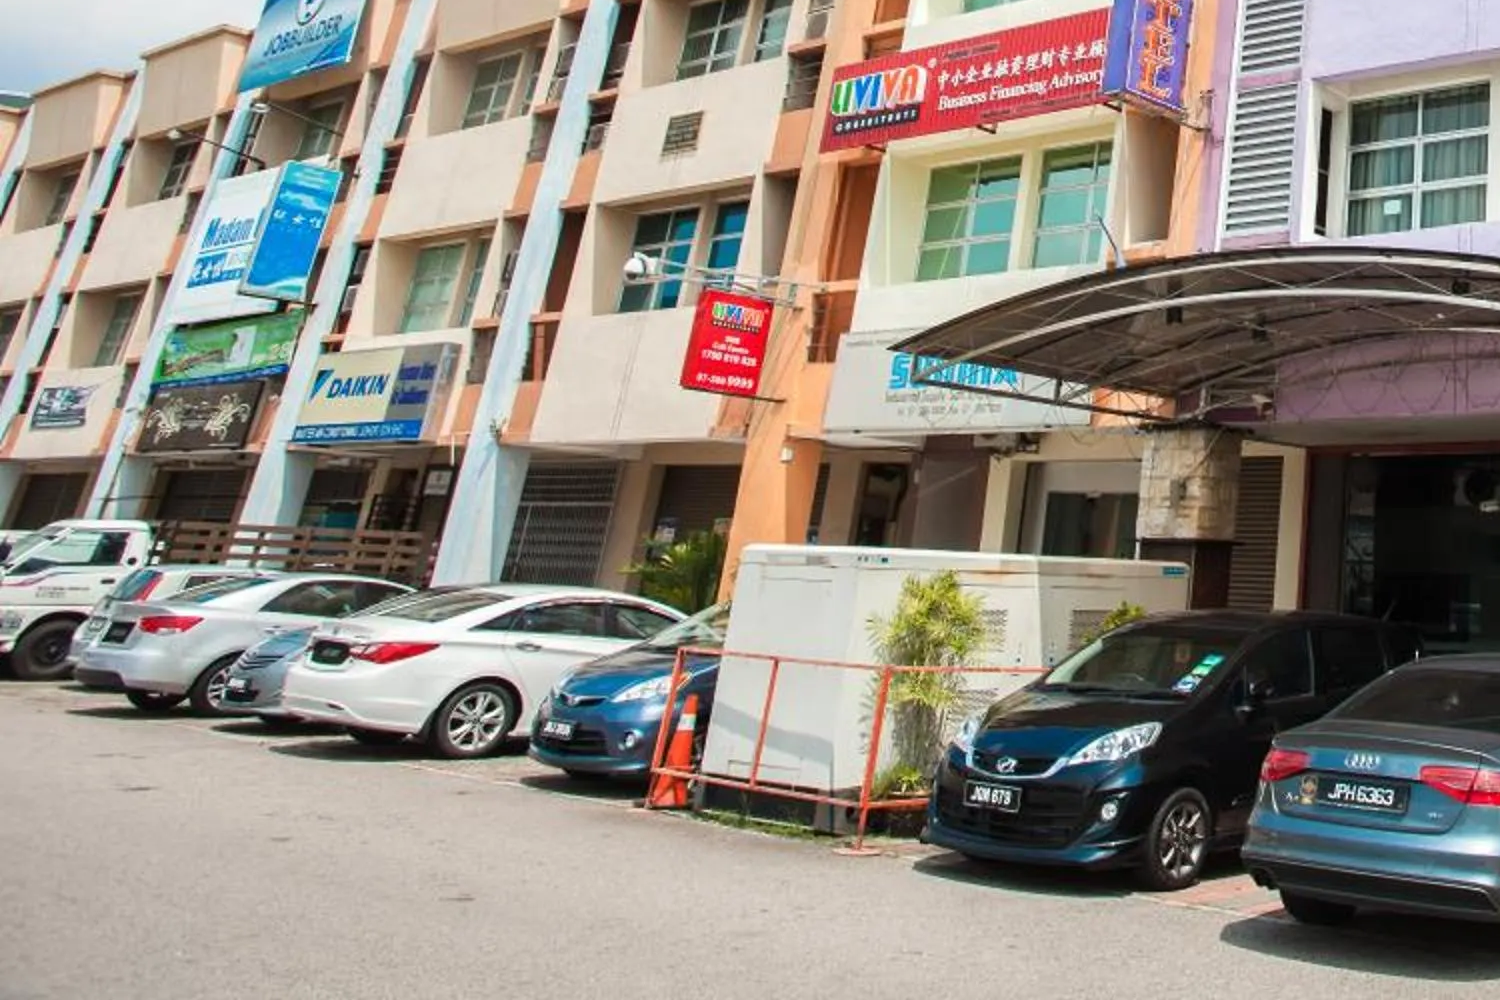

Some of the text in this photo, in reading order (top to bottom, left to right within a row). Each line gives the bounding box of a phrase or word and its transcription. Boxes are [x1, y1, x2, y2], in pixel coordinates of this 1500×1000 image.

[263, 14, 343, 57] JOBBUILDER
[831, 64, 927, 116] UVIVA
[938, 91, 988, 110] Business
[989, 80, 1049, 101] Financing
[202, 217, 256, 249] Madam
[326, 375, 390, 399] DAIKIN
